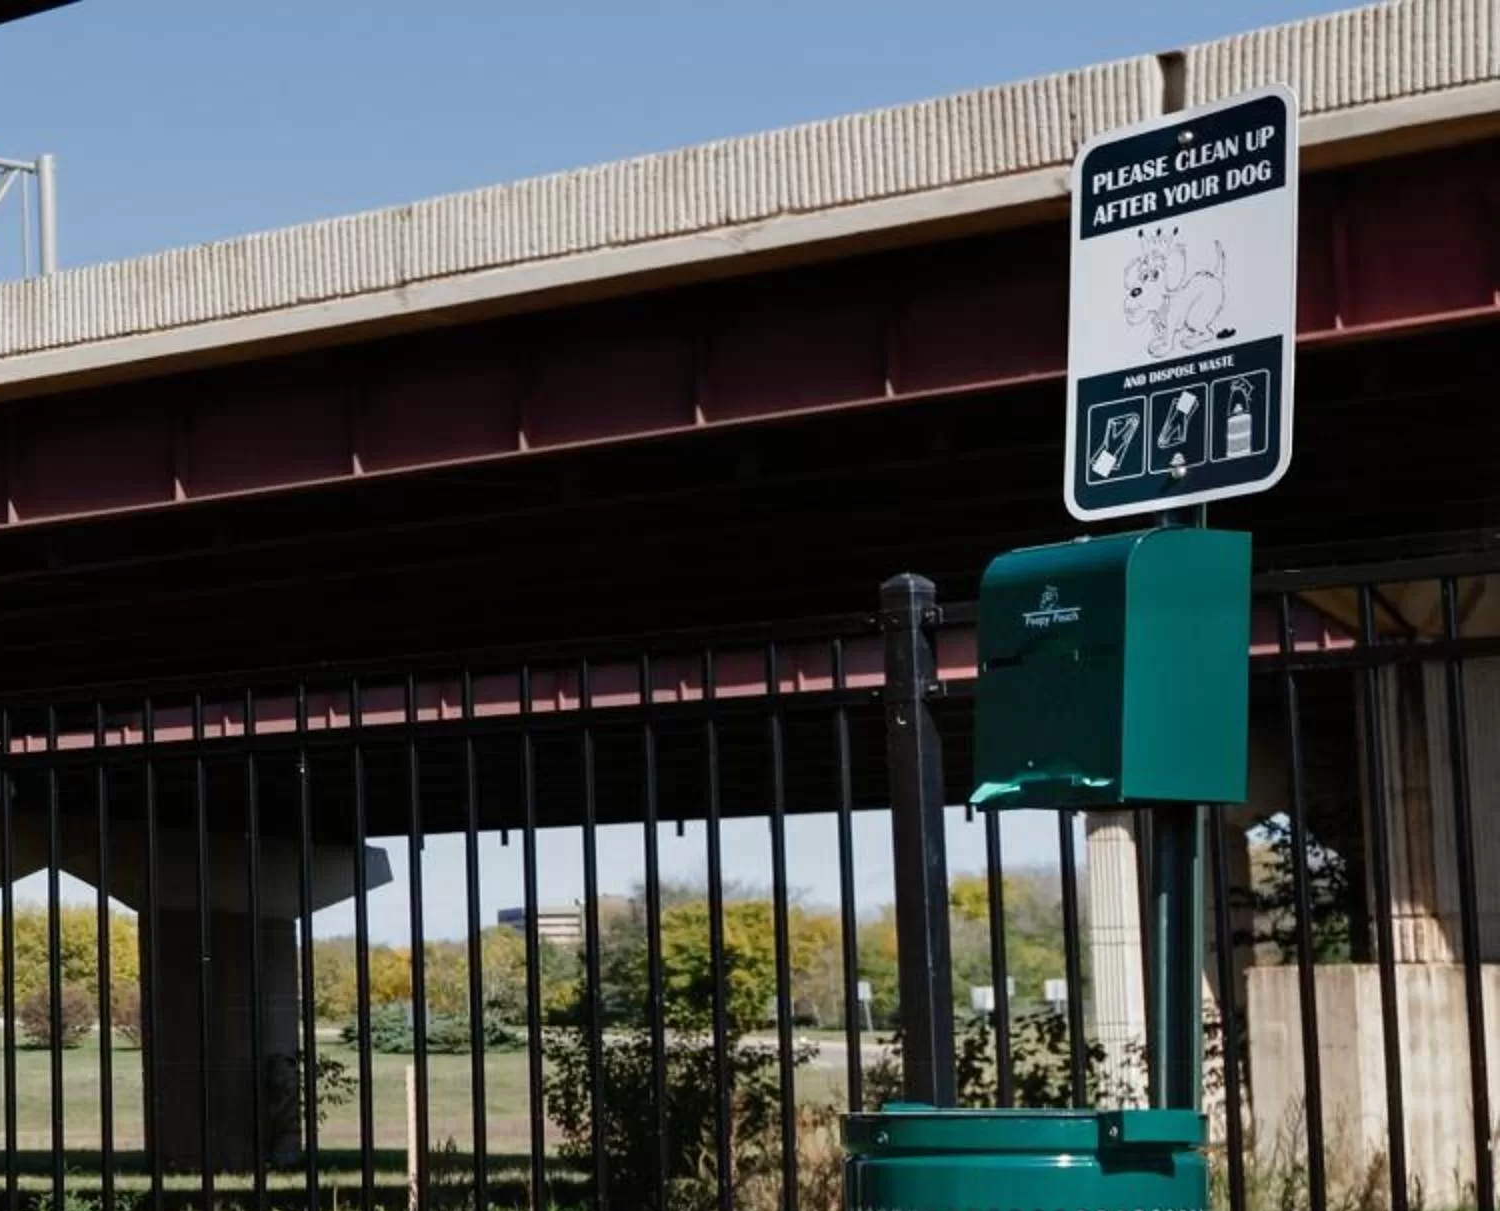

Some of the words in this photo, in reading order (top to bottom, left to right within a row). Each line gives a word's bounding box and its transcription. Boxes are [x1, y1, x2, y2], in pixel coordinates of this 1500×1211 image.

[1093, 156, 1169, 195] PLEASE
[1175, 135, 1239, 171] CLEAN
[1245, 125, 1275, 151] UP
[1093, 192, 1157, 227] AFTER
[1164, 175, 1219, 207] YOUR
[1226, 160, 1272, 191] DOG
[1123, 373, 1147, 389] AND
[1149, 363, 1197, 384] DISPOSE
[1198, 354, 1235, 373] WASTE
